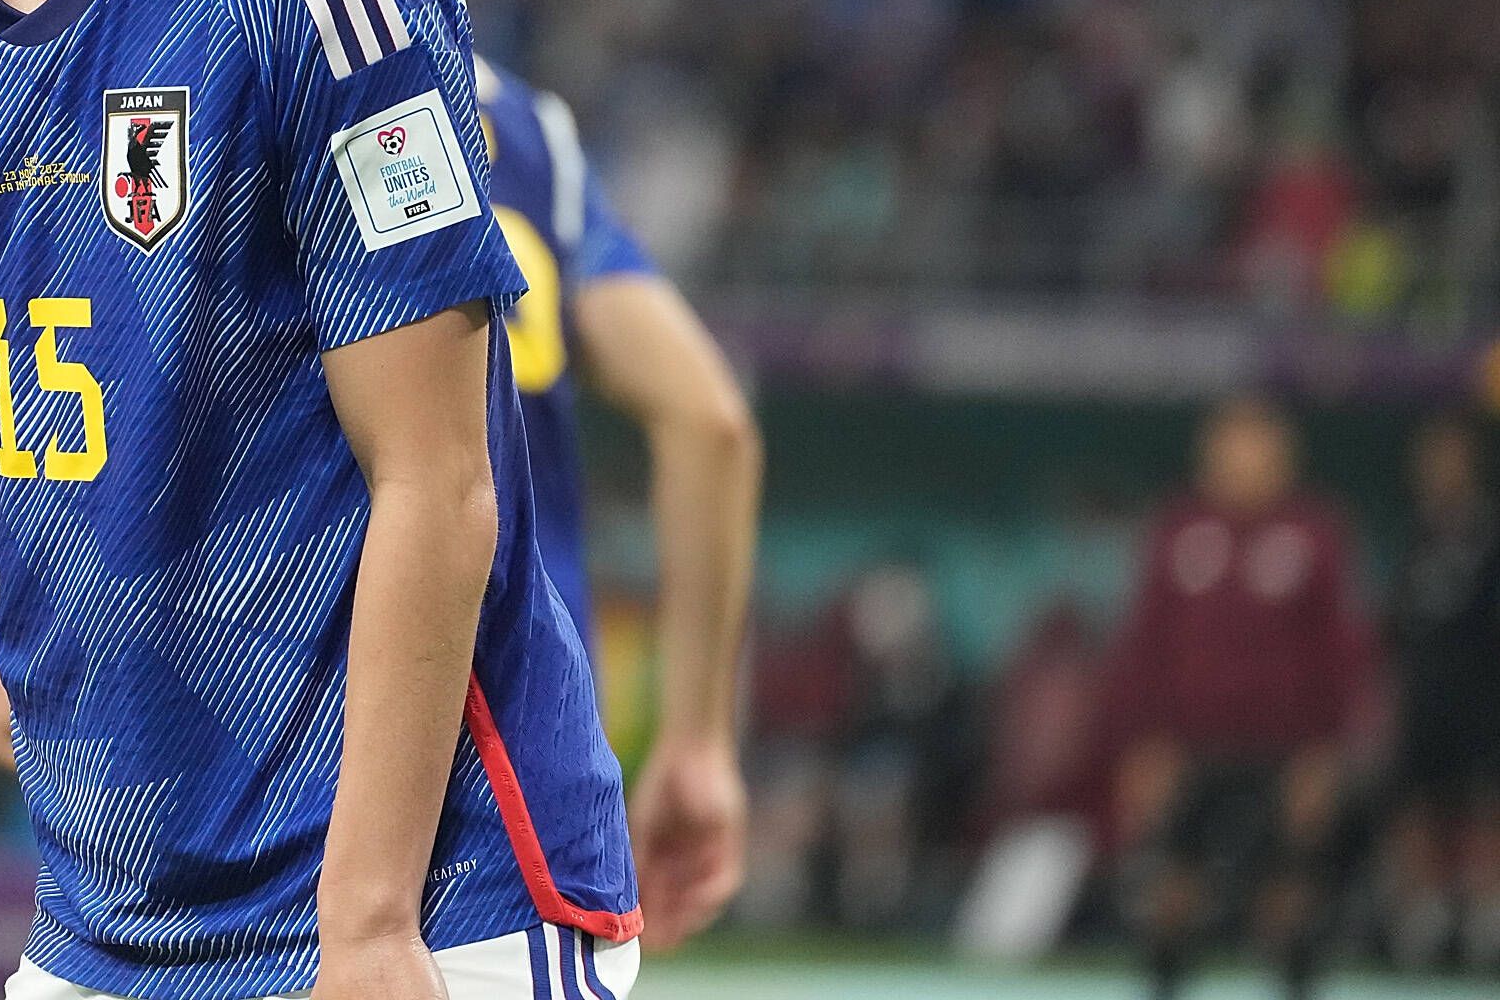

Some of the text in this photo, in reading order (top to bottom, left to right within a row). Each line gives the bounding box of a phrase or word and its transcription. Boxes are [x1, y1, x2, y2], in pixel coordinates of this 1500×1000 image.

[120, 95, 163, 109] JAPAN
[3, 171, 16, 181] 23
[40, 163, 65, 175] 2022
[380, 155, 424, 178] FOOTBALL
[384, 167, 430, 193] UNITES
[388, 181, 437, 208] the World
[125, 199, 162, 223] JFA
[406, 203, 429, 216] FIFA
